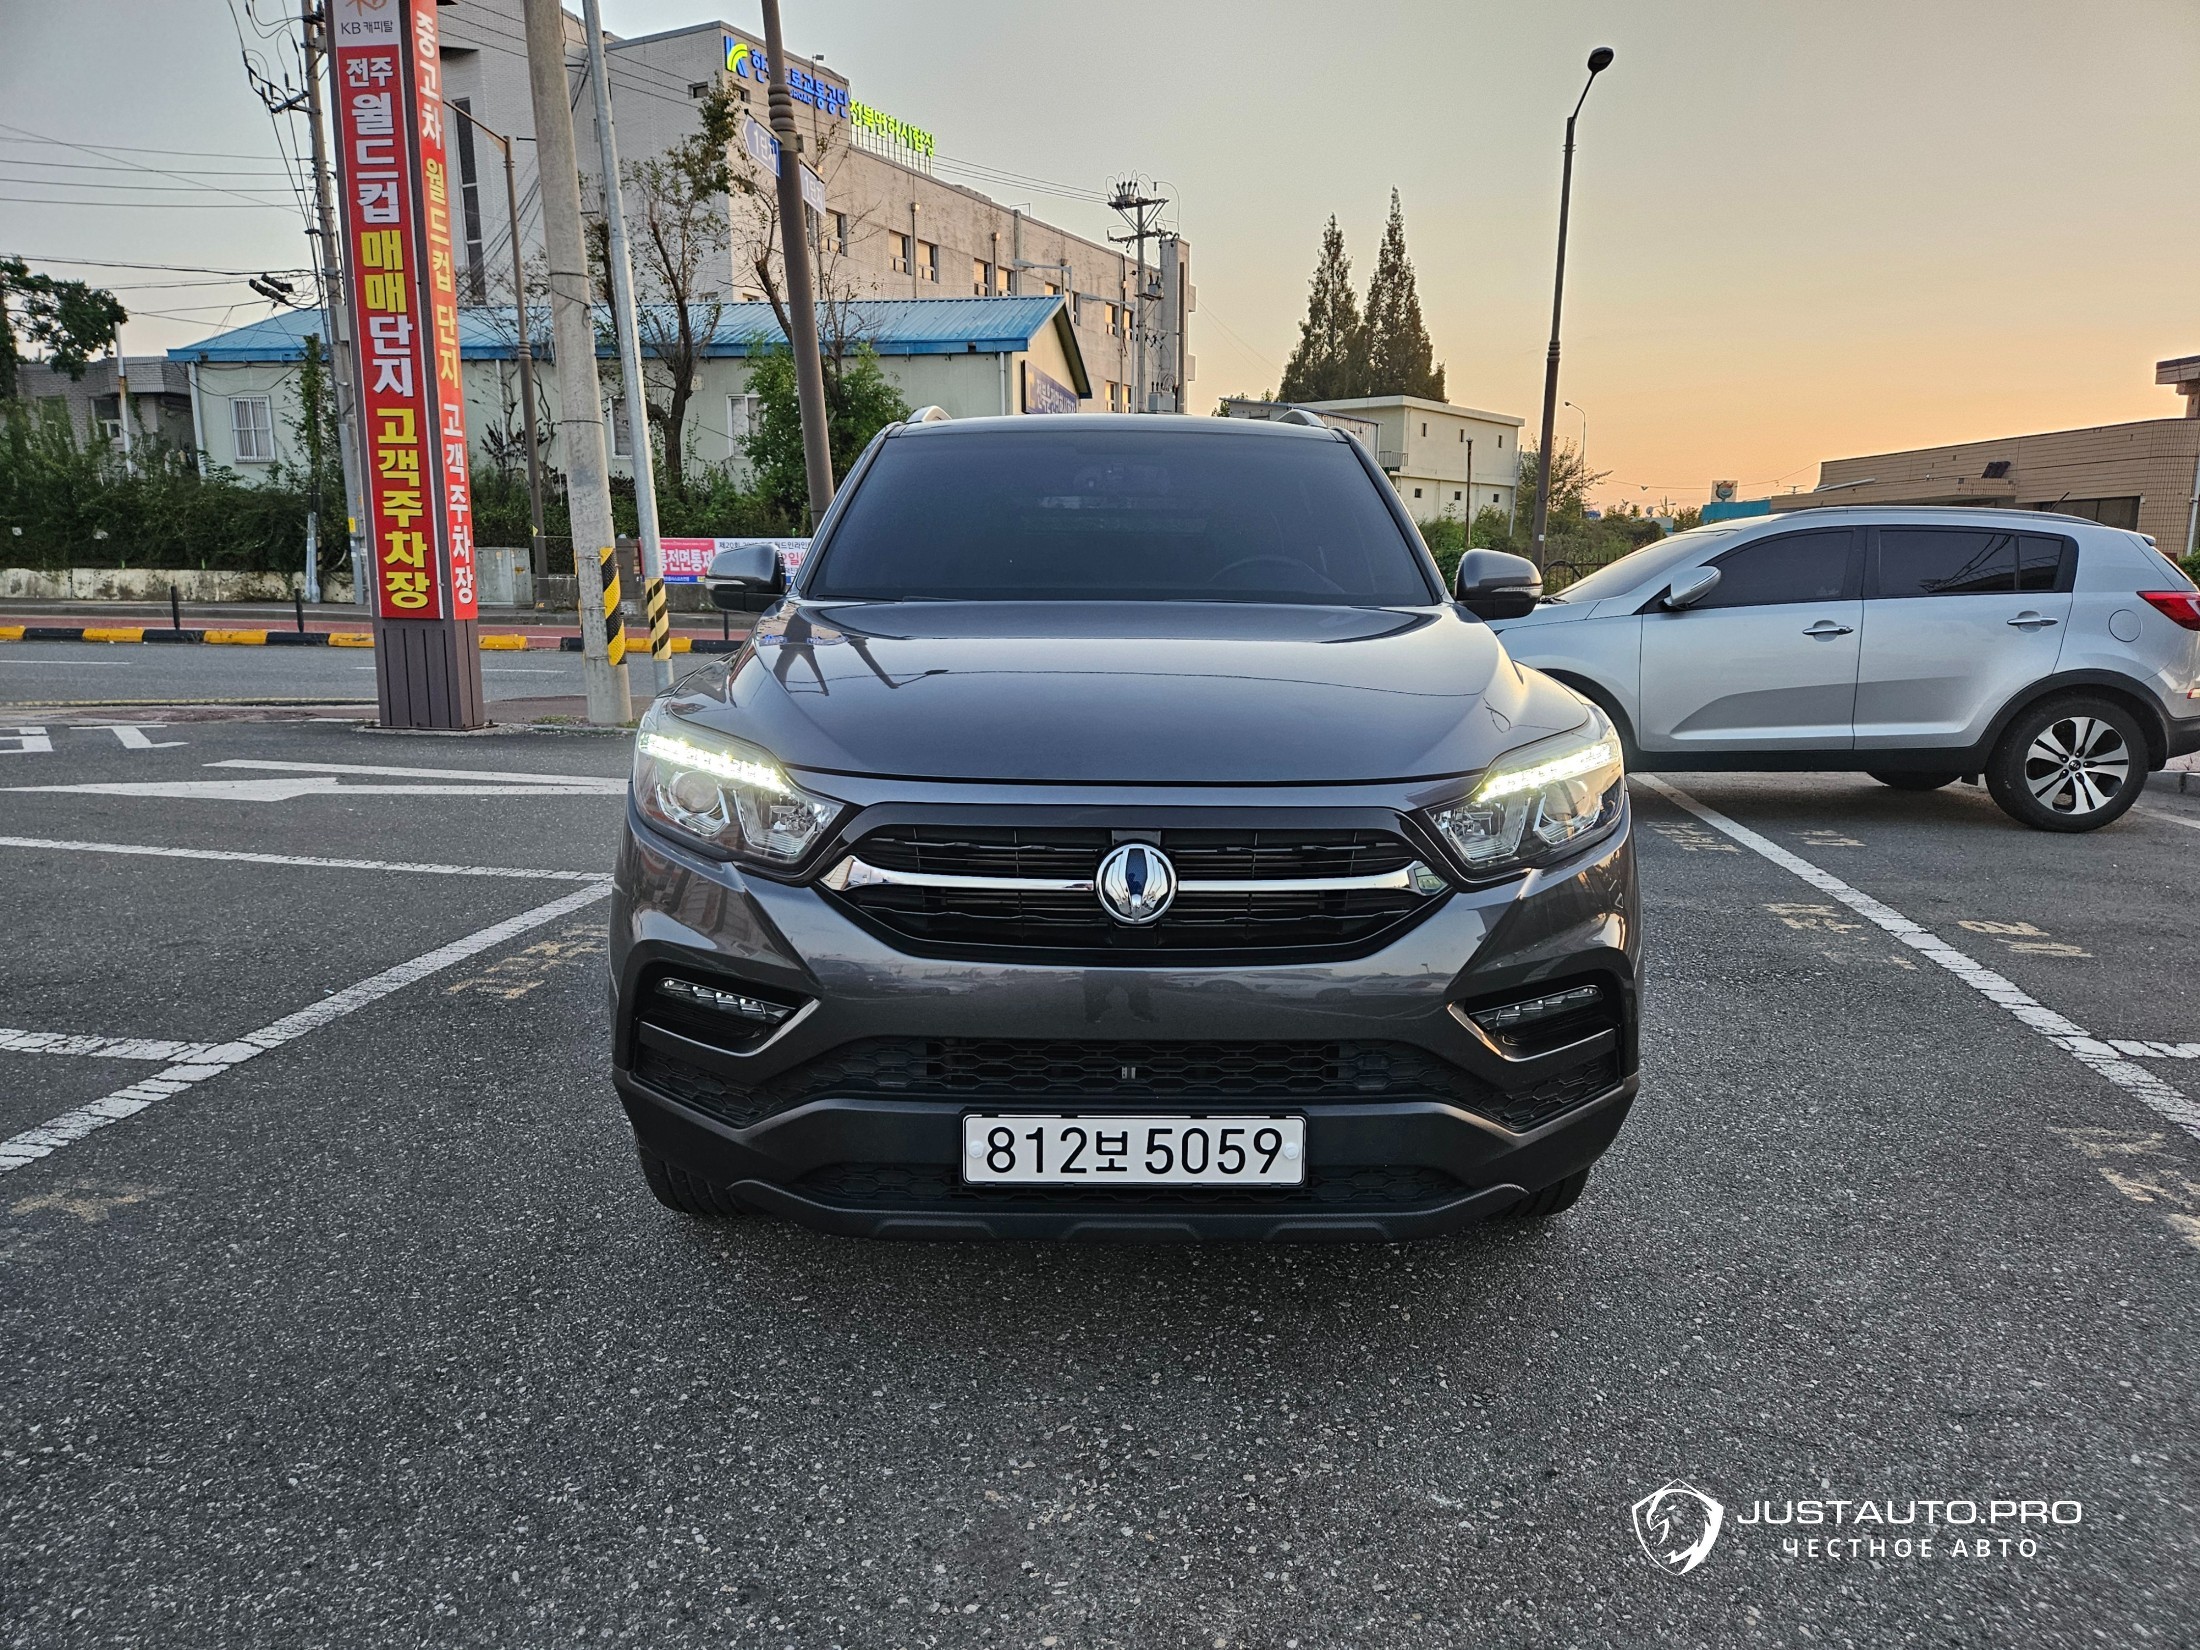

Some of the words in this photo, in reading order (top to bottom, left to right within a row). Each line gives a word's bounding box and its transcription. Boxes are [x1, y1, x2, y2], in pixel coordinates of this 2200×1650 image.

[340, 22, 361, 35] KB
[363, 20, 394, 34] 캐피탈
[346, 57, 394, 87] 전주
[376, 407, 431, 610] 고객주차장
[415, 9, 442, 150] 중고차
[443, 402, 474, 604] 고객주차장
